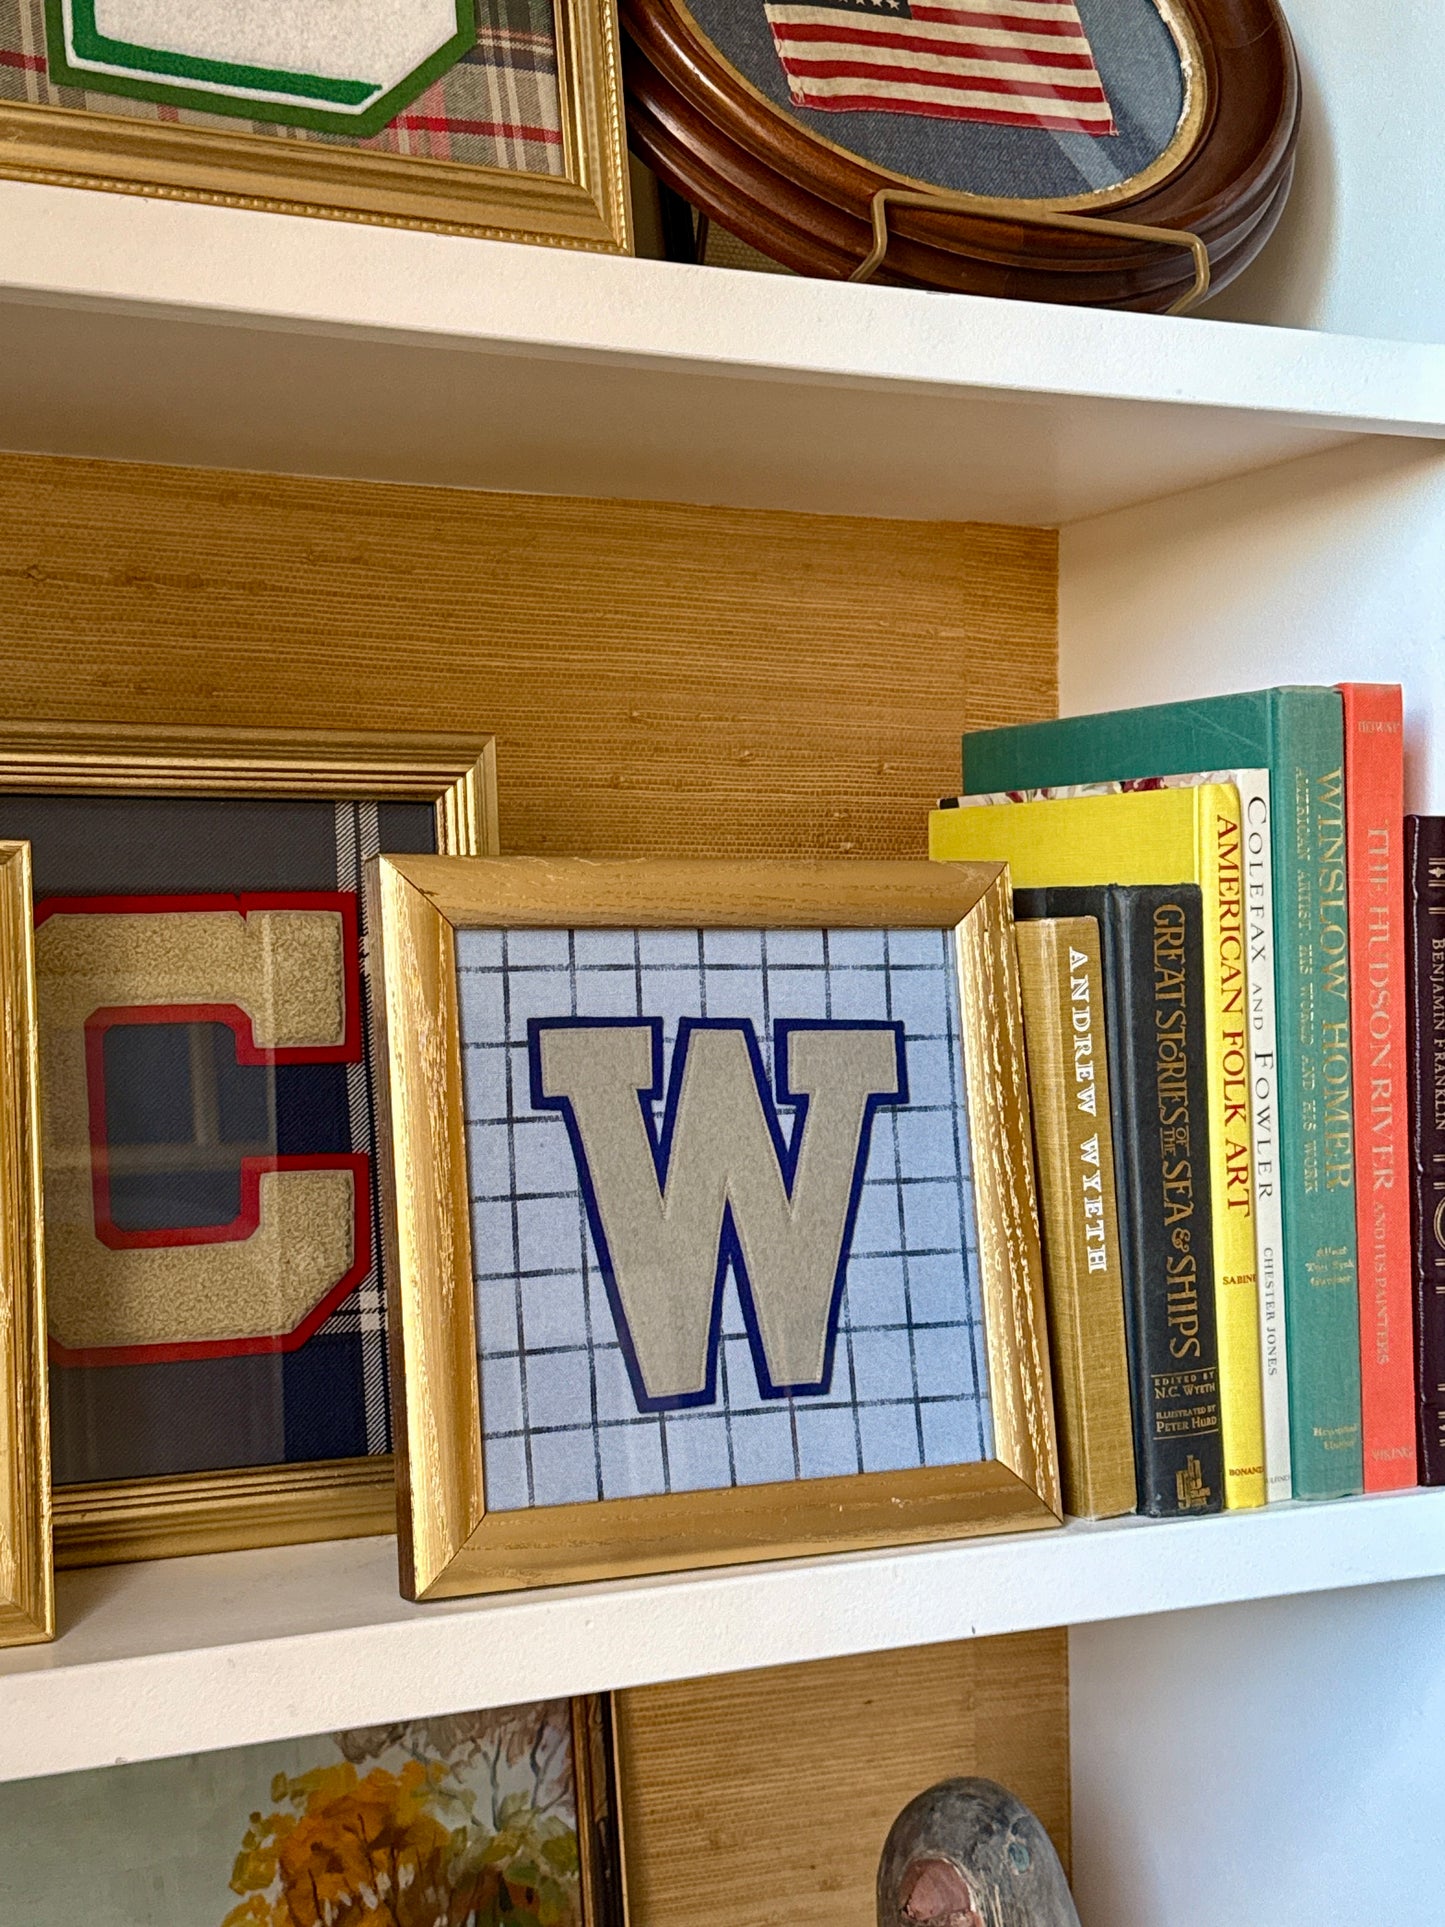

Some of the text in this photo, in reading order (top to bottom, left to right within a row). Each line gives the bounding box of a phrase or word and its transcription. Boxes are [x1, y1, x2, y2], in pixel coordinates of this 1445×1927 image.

[1295, 766, 1311, 862] AMERICAN
[1367, 817, 1390, 898] THE
[1316, 767, 1347, 1002] WINSLOW
[1217, 814, 1251, 1218] AMERICAN FOLK ART
[1247, 796, 1274, 1200] COLEFAX AND FOWLER
[1367, 905, 1392, 1068] HUDSON
[1431, 938, 1445, 1131] BENJAMIN FRANKLIN
[1069, 946, 1108, 1275] ANDREW WYETH
[1301, 1054, 1316, 1091] AND
[1302, 1099, 1317, 1132] HIS
[1153, 903, 1202, 1359] GREAT STORIES OF THE SEA & SHIPS
[1304, 1139, 1319, 1195] WORK
[1369, 1076, 1394, 1191] RIVER
[527, 1016, 910, 1414] W
[1263, 1247, 1278, 1376] CHESTER JONES
[1375, 1277, 1390, 1366] PAINTERS
[1154, 1371, 1215, 1386] EDITED BY
[1154, 1382, 1216, 1399] N.C. WYETH
[1156, 1404, 1217, 1420] ILLUSTRATED BY
[1156, 1415, 1218, 1432] PETER HURD
